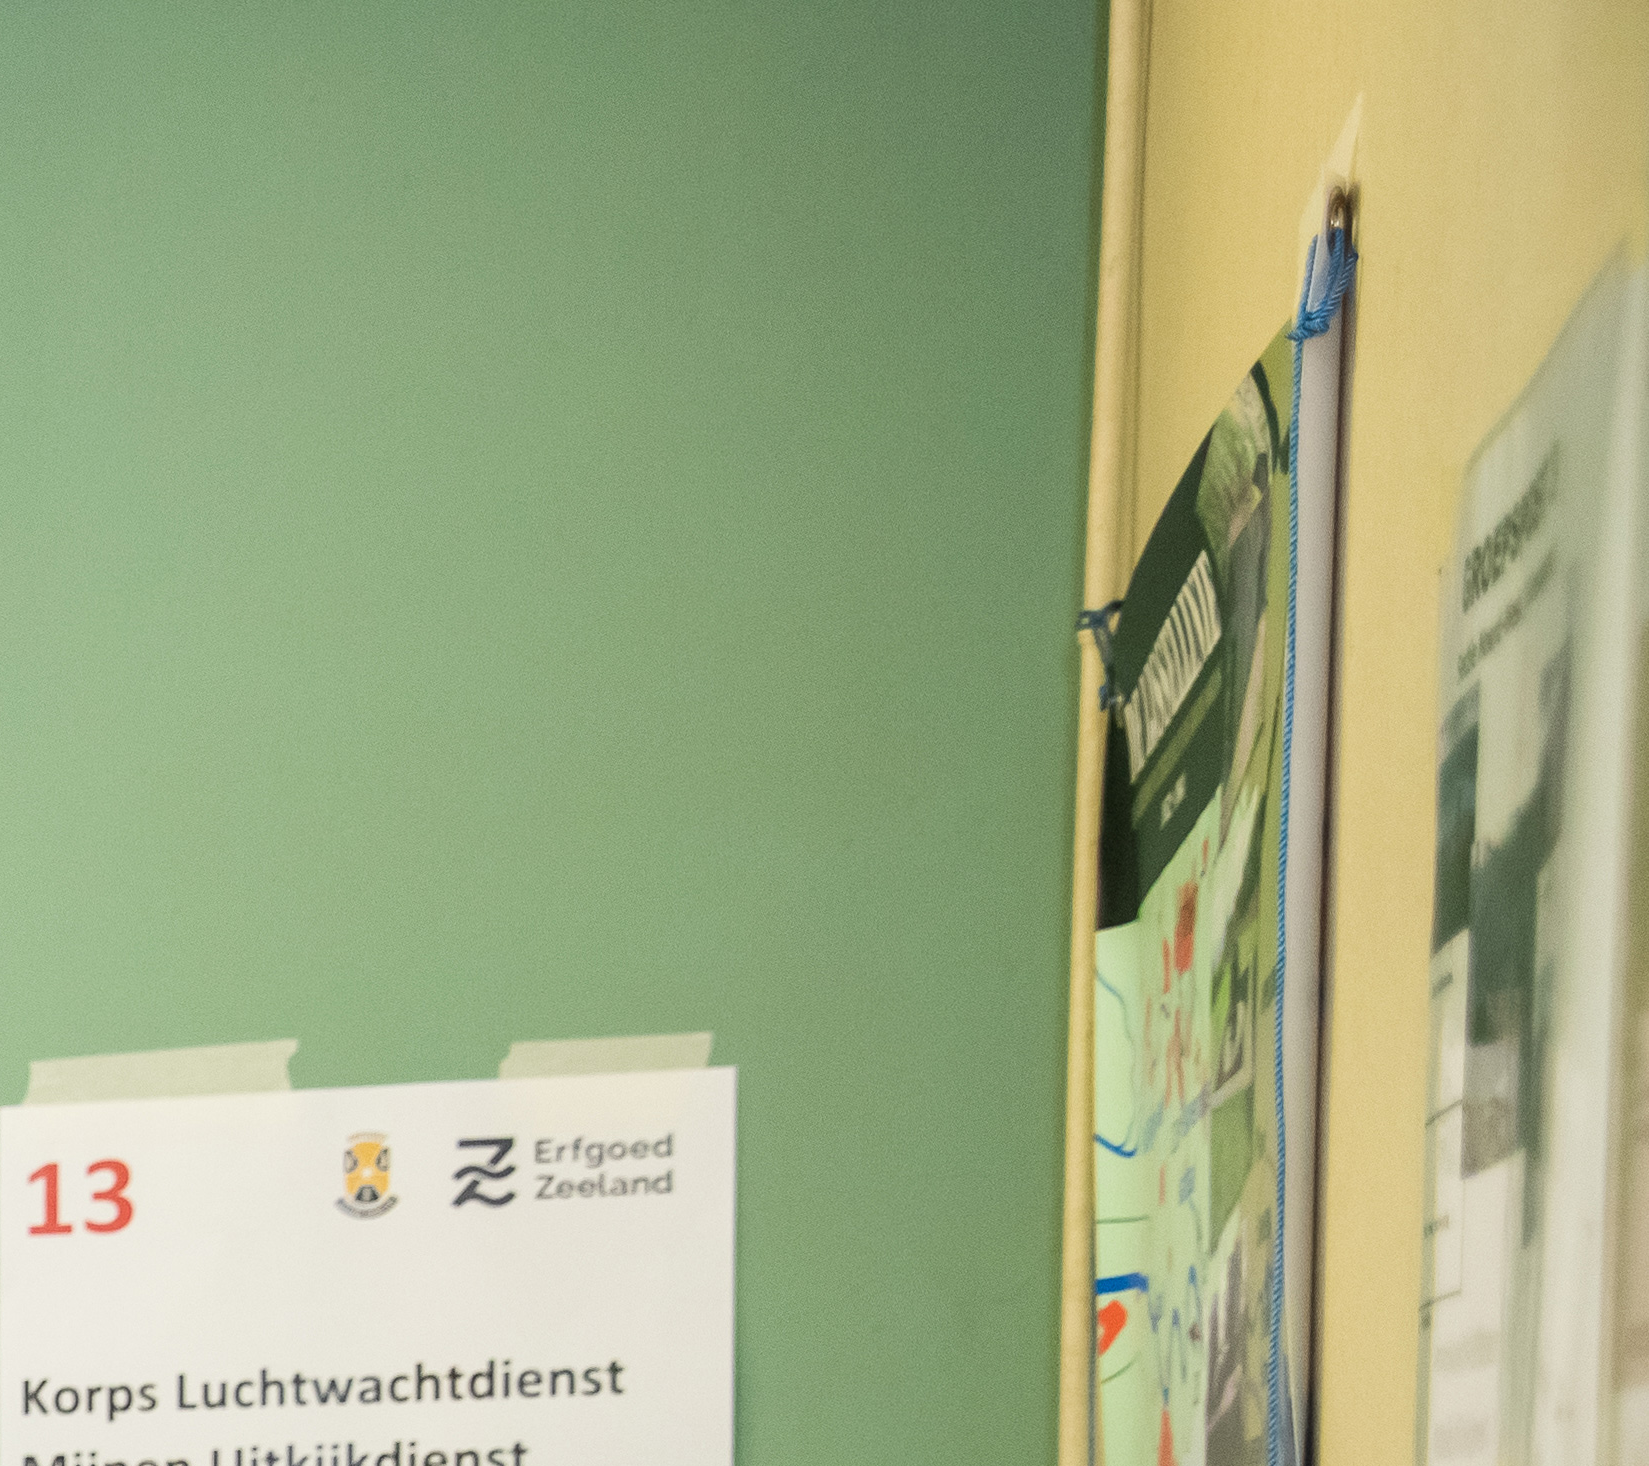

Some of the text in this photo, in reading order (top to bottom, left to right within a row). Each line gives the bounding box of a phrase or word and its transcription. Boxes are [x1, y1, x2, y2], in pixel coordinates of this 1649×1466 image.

[533, 1133, 675, 1169] Erfgoed
[26, 1159, 135, 1236] 13
[533, 1171, 675, 1201] Zeeland
[22, 1359, 626, 1421] Korps Luchtwachtdienst
